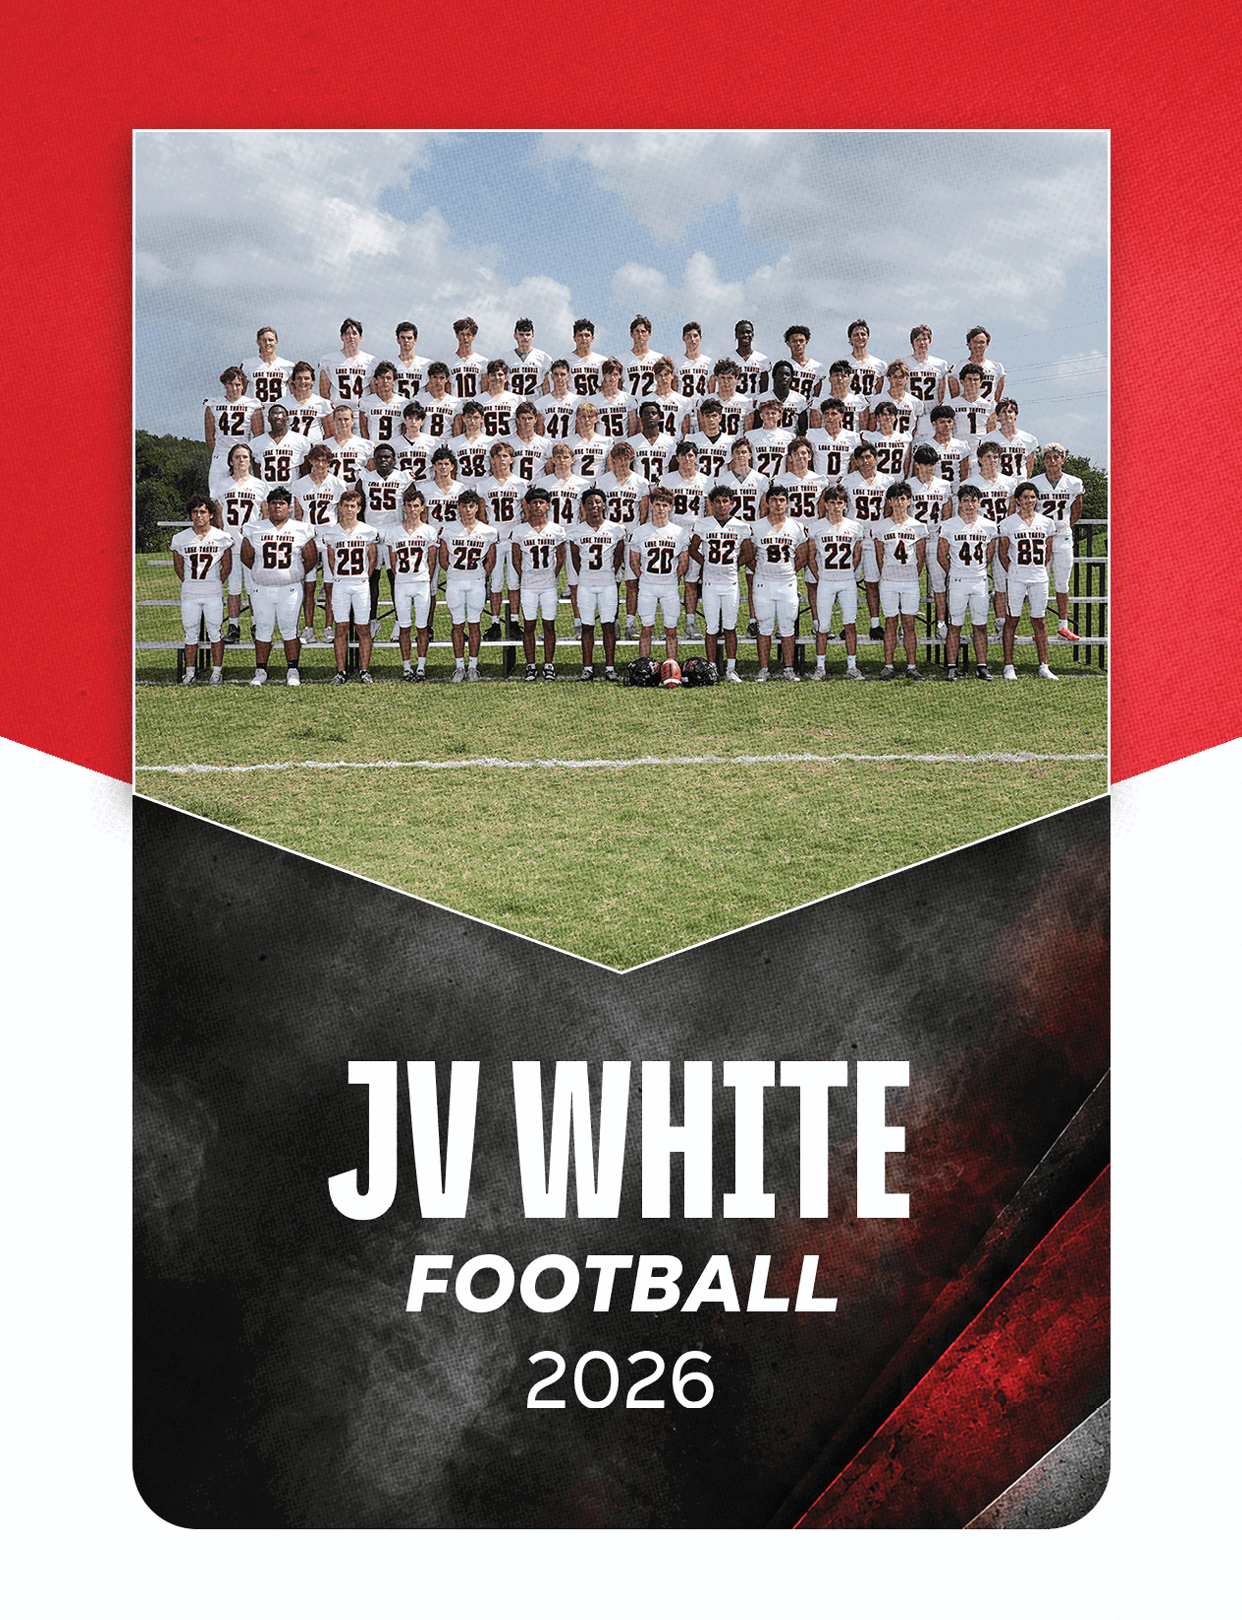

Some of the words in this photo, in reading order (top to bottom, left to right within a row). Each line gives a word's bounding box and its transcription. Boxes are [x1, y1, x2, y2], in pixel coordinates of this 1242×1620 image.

[255, 378, 282, 402] 89
[339, 375, 363, 399] 54
[455, 374, 477, 397] 10
[511, 373, 537, 395] 92
[574, 374, 599, 395] 60
[629, 373, 654, 396] 72
[682, 375, 706, 397] 84
[736, 373, 758, 394] 31
[851, 375, 874, 395] 40
[910, 377, 936, 401] 52
[219, 411, 244, 435] 42
[379, 416, 392, 441] 9
[430, 413, 444, 436] 8
[484, 412, 510, 436] 65
[547, 414, 568, 438] 41
[601, 414, 623, 436] 15
[968, 413, 976, 434] 1
[264, 456, 290, 482] 58
[459, 455, 486, 477] 38
[520, 457, 533, 480] 6
[581, 455, 595, 476] 2
[641, 457, 663, 483] 13
[699, 455, 725, 477] 37
[757, 453, 783, 478] 27
[827, 451, 841, 475] 0
[876, 449, 904, 474] 28
[941, 461, 955, 482] 5
[1001, 454, 1022, 477] 81
[369, 488, 396, 510] 55
[491, 498, 514, 522] 16
[554, 498, 573, 523] 14
[609, 498, 634, 523] 33
[789, 492, 815, 517] 35
[227, 499, 254, 525] 57
[309, 500, 330, 525] 12
[432, 504, 457, 521] 45
[915, 501, 940, 523] 24
[263, 542, 292, 569] 63
[337, 548, 364, 575] 29
[396, 547, 424, 573] 87
[453, 547, 481, 570] 26
[530, 546, 549, 569] 11
[589, 544, 603, 570] 3
[647, 547, 674, 574] 20
[708, 539, 736, 565] 82
[825, 543, 852, 569] 22
[894, 540, 908, 564] 4
[959, 541, 983, 566] 44
[1018, 539, 1044, 565] 85
[190, 553, 213, 579] 17
